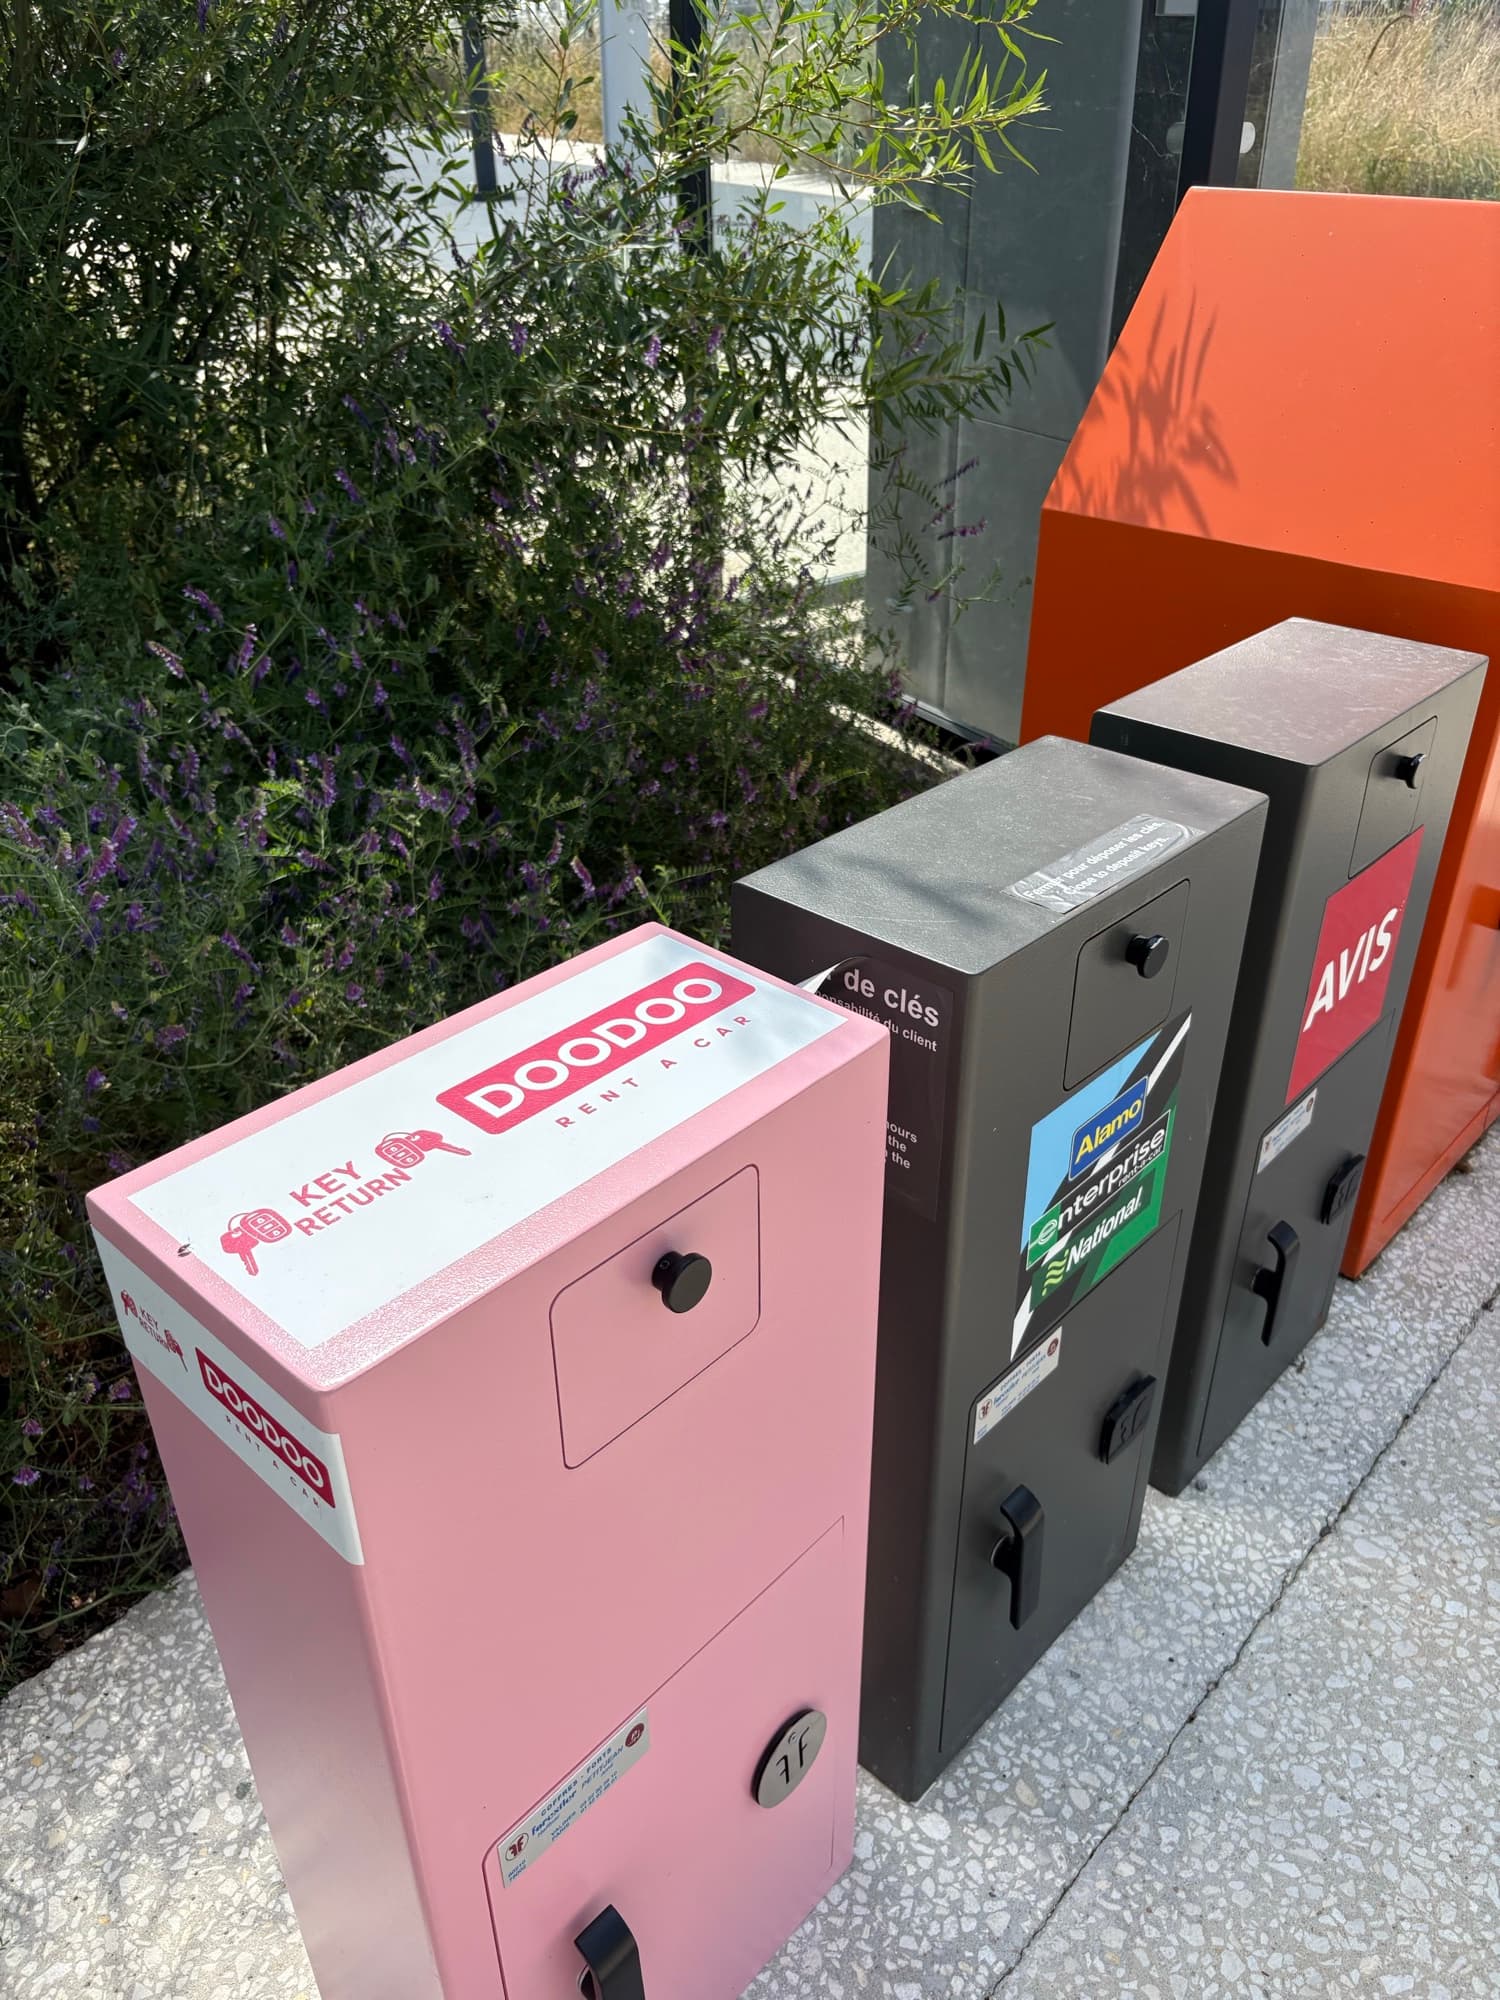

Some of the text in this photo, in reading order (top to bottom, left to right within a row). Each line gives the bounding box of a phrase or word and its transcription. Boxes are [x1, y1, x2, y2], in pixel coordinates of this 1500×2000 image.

[1063, 862, 1089, 880] pour
[1124, 832, 1143, 844] les
[1063, 877, 1096, 895] Close
[1093, 869, 1109, 880] to
[1107, 849, 1145, 873] deposit
[844, 969, 939, 1027] de clés
[1303, 907, 1398, 1033] AVIS
[464, 977, 724, 1119] DOODOO
[884, 1018, 899, 1034] du
[903, 1029, 938, 1052] client
[555, 1014, 751, 1129] RENT A CAR
[888, 1135, 907, 1152] the
[892, 1152, 911, 1169] the
[1074, 1098, 1143, 1165] Alamo
[288, 1160, 362, 1208] KEY
[1037, 1127, 1166, 1246] enterprise
[1118, 1144, 1162, 1188] rent-a-car
[293, 1167, 413, 1237] RETURN
[1065, 1186, 1143, 1273] National
[140, 1305, 159, 1330] KEY
[206, 1363, 324, 1489] DOODOO
[225, 1415, 321, 1509] RENT A CAR
[540, 1779, 578, 1816] COFFRES
[586, 1747, 612, 1774] FORTS
